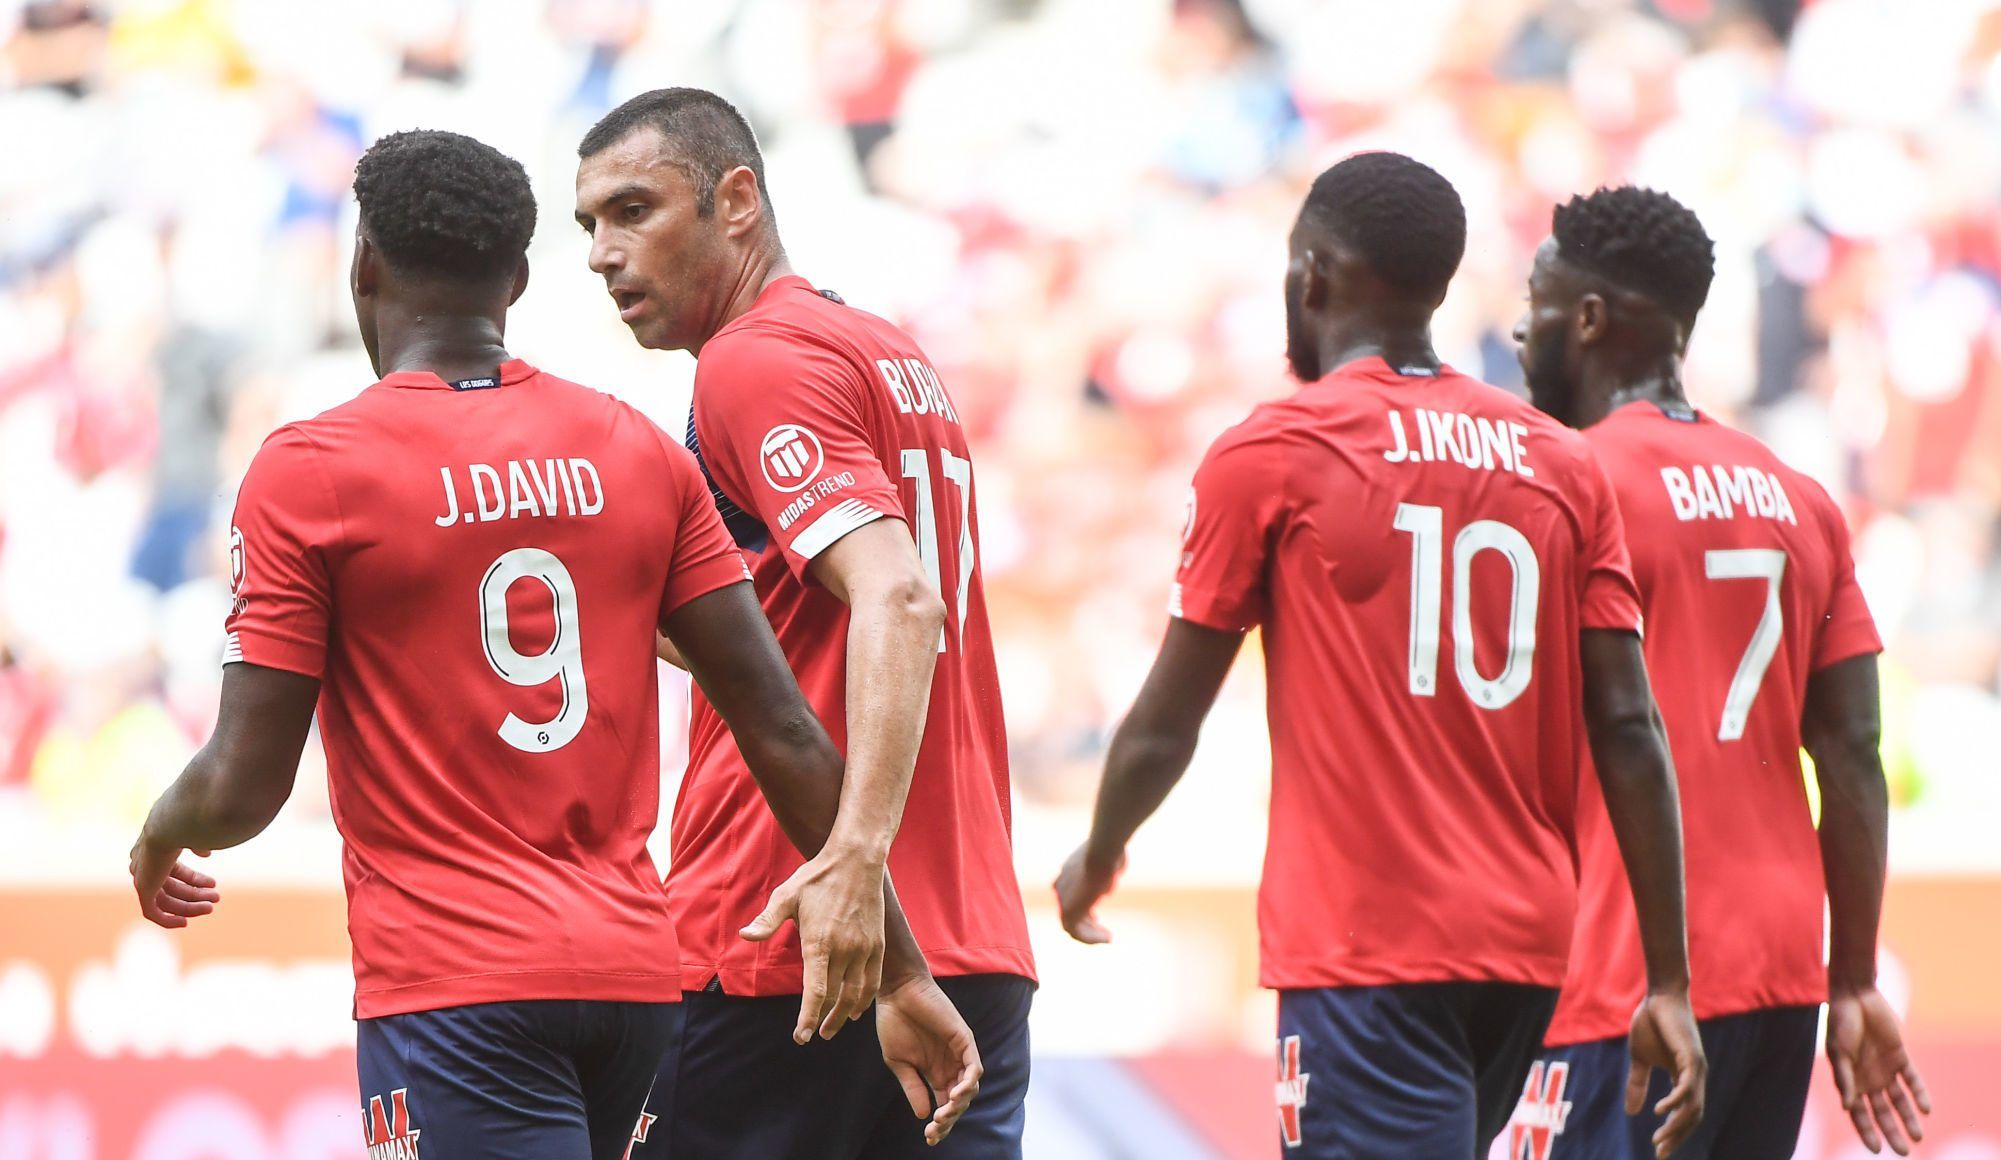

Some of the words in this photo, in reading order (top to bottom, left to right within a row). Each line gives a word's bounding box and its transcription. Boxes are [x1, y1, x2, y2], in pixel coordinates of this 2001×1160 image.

[435, 457, 604, 528] J.DAVID
[777, 471, 856, 531] MIDASTREND
[1384, 408, 1535, 477] J.IKONE
[1661, 466, 1797, 526] BAMBA
[900, 448, 974, 659] 17
[1393, 502, 1540, 710] 10
[479, 547, 589, 753] 9
[1705, 549, 1786, 741] 7
